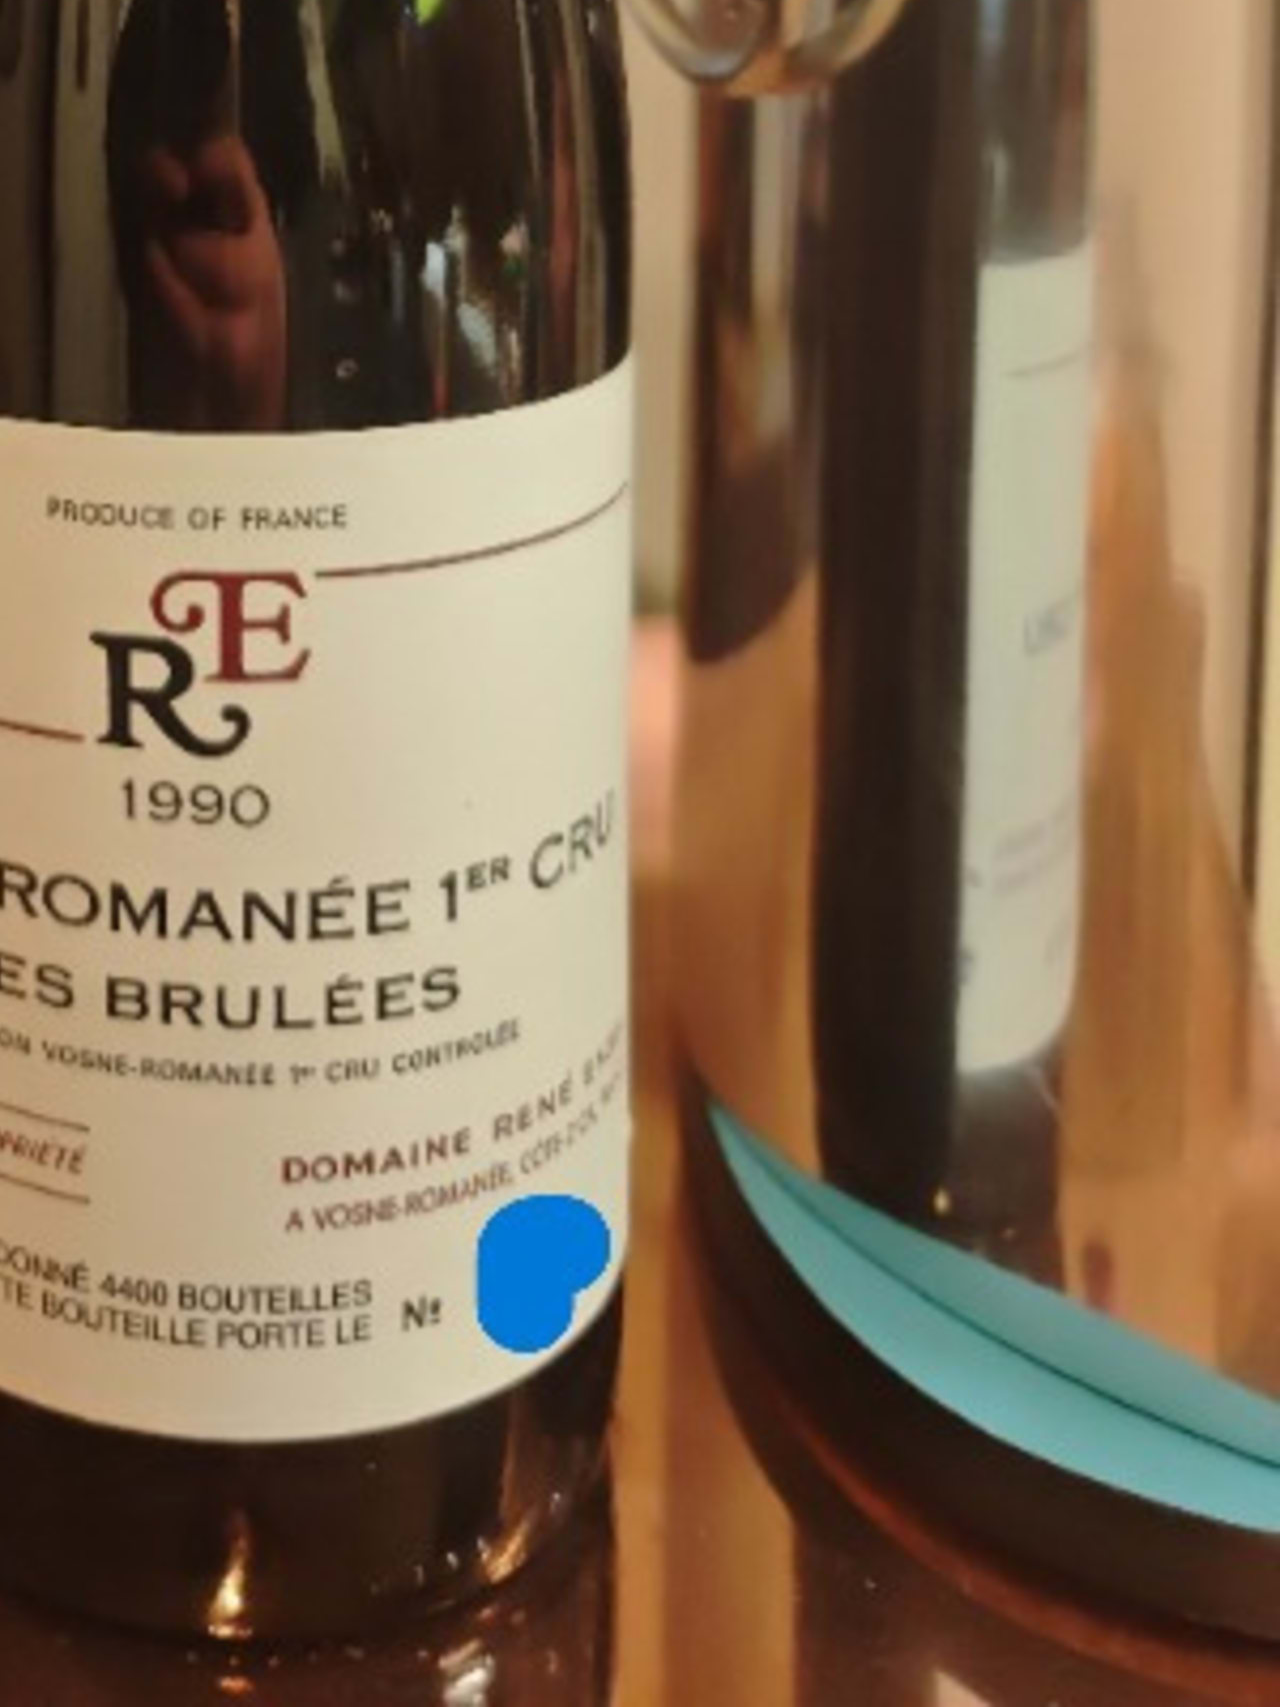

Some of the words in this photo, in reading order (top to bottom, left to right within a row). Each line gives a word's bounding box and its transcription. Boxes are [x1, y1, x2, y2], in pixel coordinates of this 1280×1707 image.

[46, 495, 174, 530] PRODUCE
[187, 506, 226, 530] OF
[241, 503, 348, 530] FRANCE
[121, 776, 271, 829] 1990
[528, 788, 615, 890] CRU
[105, 964, 461, 1031] BRULÉES
[324, 1057, 381, 1084] CRU
[280, 1126, 471, 1185] DOMAINE
[41, 1290, 208, 1347] BOUTEILLE
[216, 1316, 326, 1350] PORTE
[335, 1313, 374, 1346] LE
[99, 1272, 169, 1308] 4400
[177, 1278, 374, 1316] BOUTEILLES
